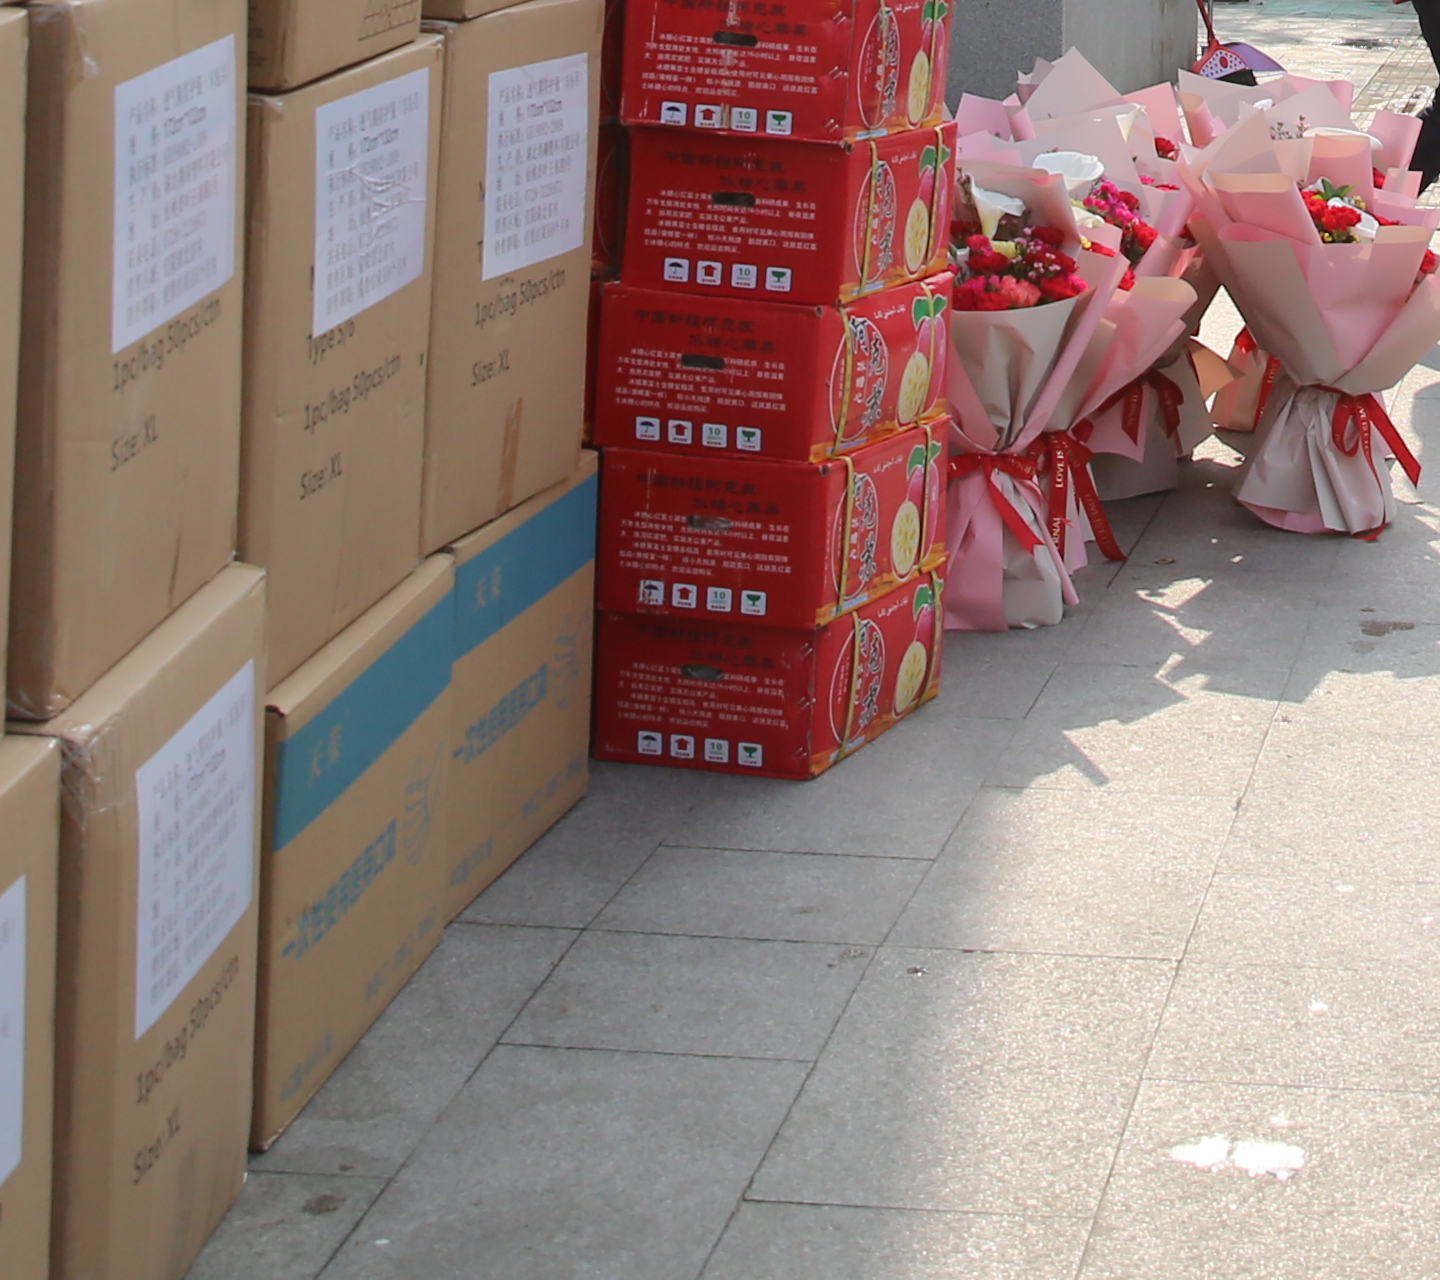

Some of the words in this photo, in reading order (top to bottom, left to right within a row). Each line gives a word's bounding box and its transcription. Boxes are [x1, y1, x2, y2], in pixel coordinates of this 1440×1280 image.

[738, 111, 750, 119] 10
[738, 267, 750, 276] 10
[519, 268, 566, 308] 50pcs/ctn
[352, 352, 402, 398] 50pcs/ctn
[471, 358, 497, 387] Size:
[498, 349, 511, 371] XL
[144, 414, 159, 443] XL
[708, 427, 721, 435] 10
[299, 464, 326, 501] Size:
[329, 452, 343, 475] XL
[713, 590, 725, 599] 10
[710, 742, 722, 751] 10
